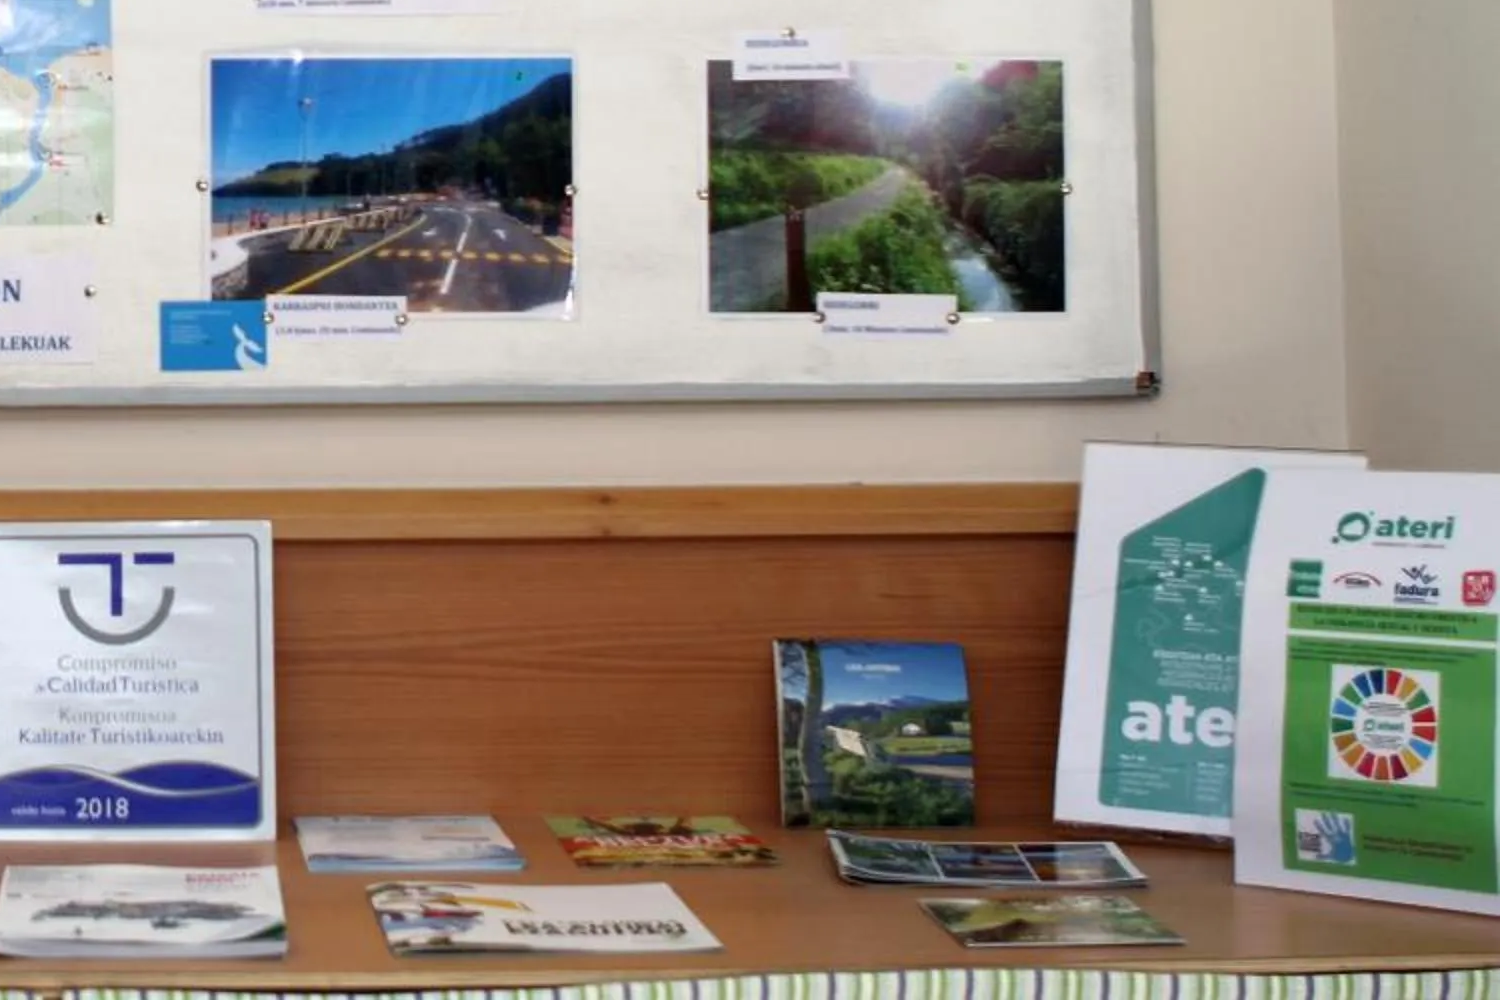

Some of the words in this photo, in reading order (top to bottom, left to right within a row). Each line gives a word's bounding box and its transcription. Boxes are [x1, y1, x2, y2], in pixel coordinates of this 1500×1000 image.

[0, 335, 72, 350] LEKUAK
[1375, 515, 1456, 539] ateri
[1393, 583, 1439, 597] fadura
[57, 654, 177, 673] Compromiso
[47, 675, 117, 693] Calidad
[19, 728, 85, 745] Kalitate
[76, 797, 129, 819] 2018
